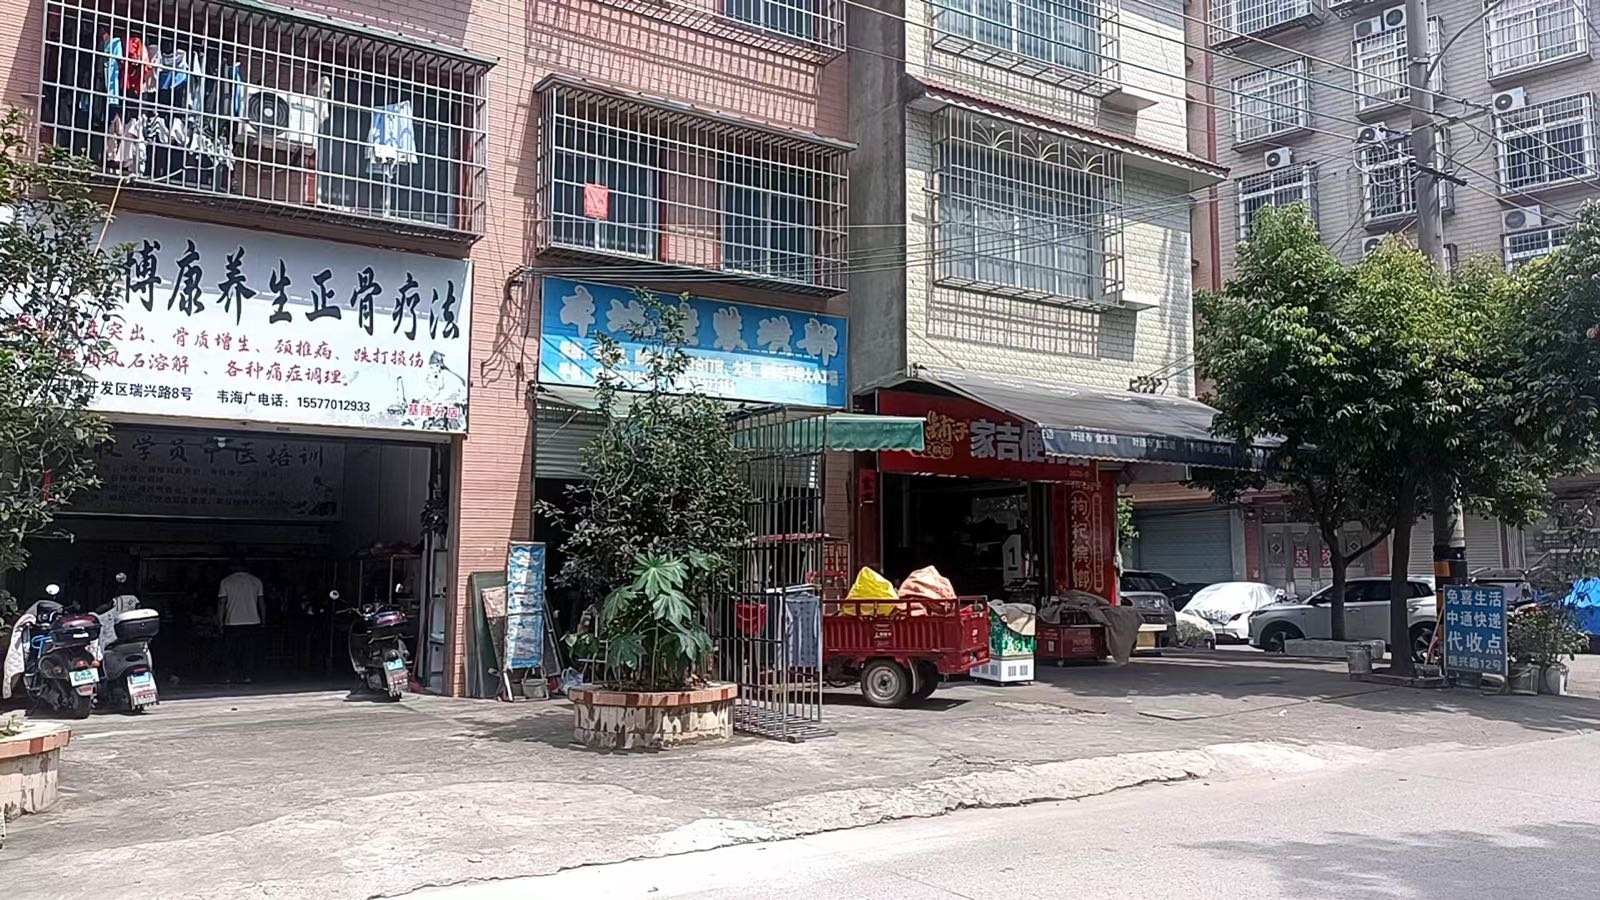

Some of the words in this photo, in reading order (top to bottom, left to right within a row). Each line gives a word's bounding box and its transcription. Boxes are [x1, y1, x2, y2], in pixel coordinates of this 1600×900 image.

[124, 238, 460, 341] 博康养生正骨疗法
[1446, 610, 1502, 629] 中通快递
[1447, 631, 1503, 655] 代收点
